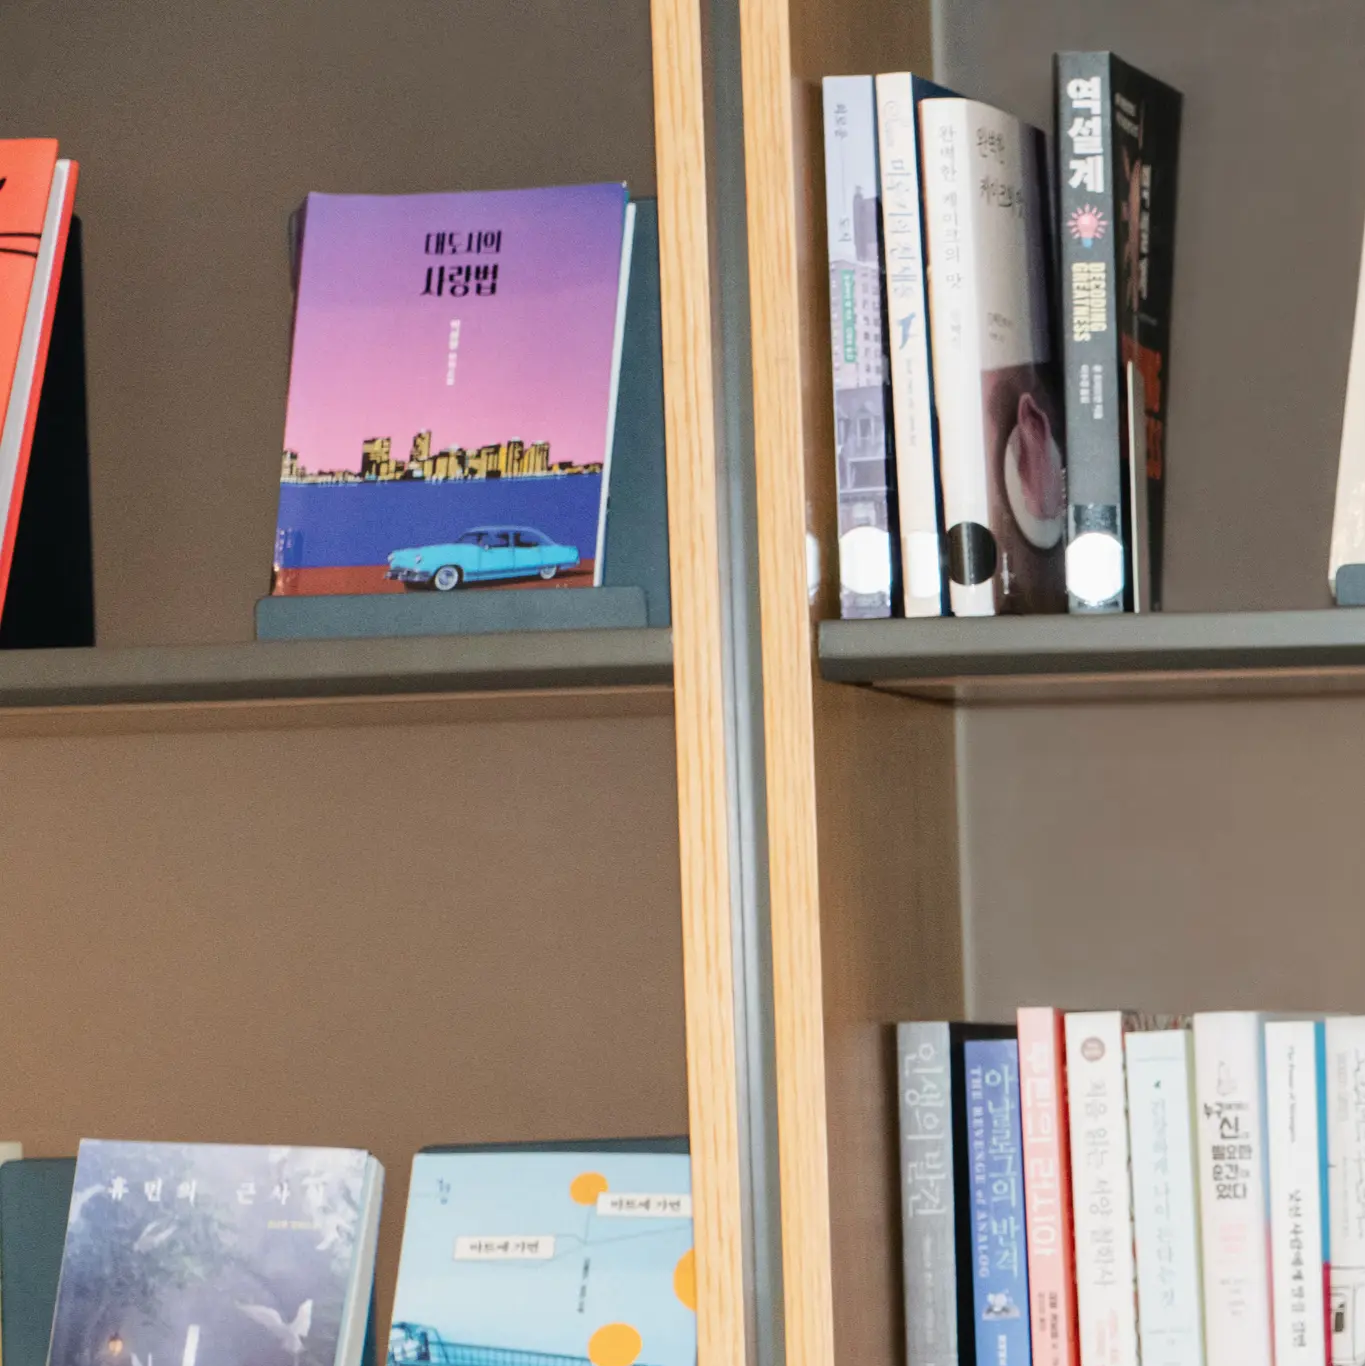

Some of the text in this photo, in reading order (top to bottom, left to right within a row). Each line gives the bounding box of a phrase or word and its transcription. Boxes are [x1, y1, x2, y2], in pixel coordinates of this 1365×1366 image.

[1066, 76, 1105, 194] 역설계
[424, 229, 502, 255] 대도시의
[420, 263, 499, 298] 사랑법
[1071, 261, 1091, 343] GREATNESS
[1088, 261, 1108, 333] DECODING
[970, 1067, 983, 1100] THE
[972, 1106, 986, 1184] REVENGE
[976, 1209, 990, 1279] ANALOG
